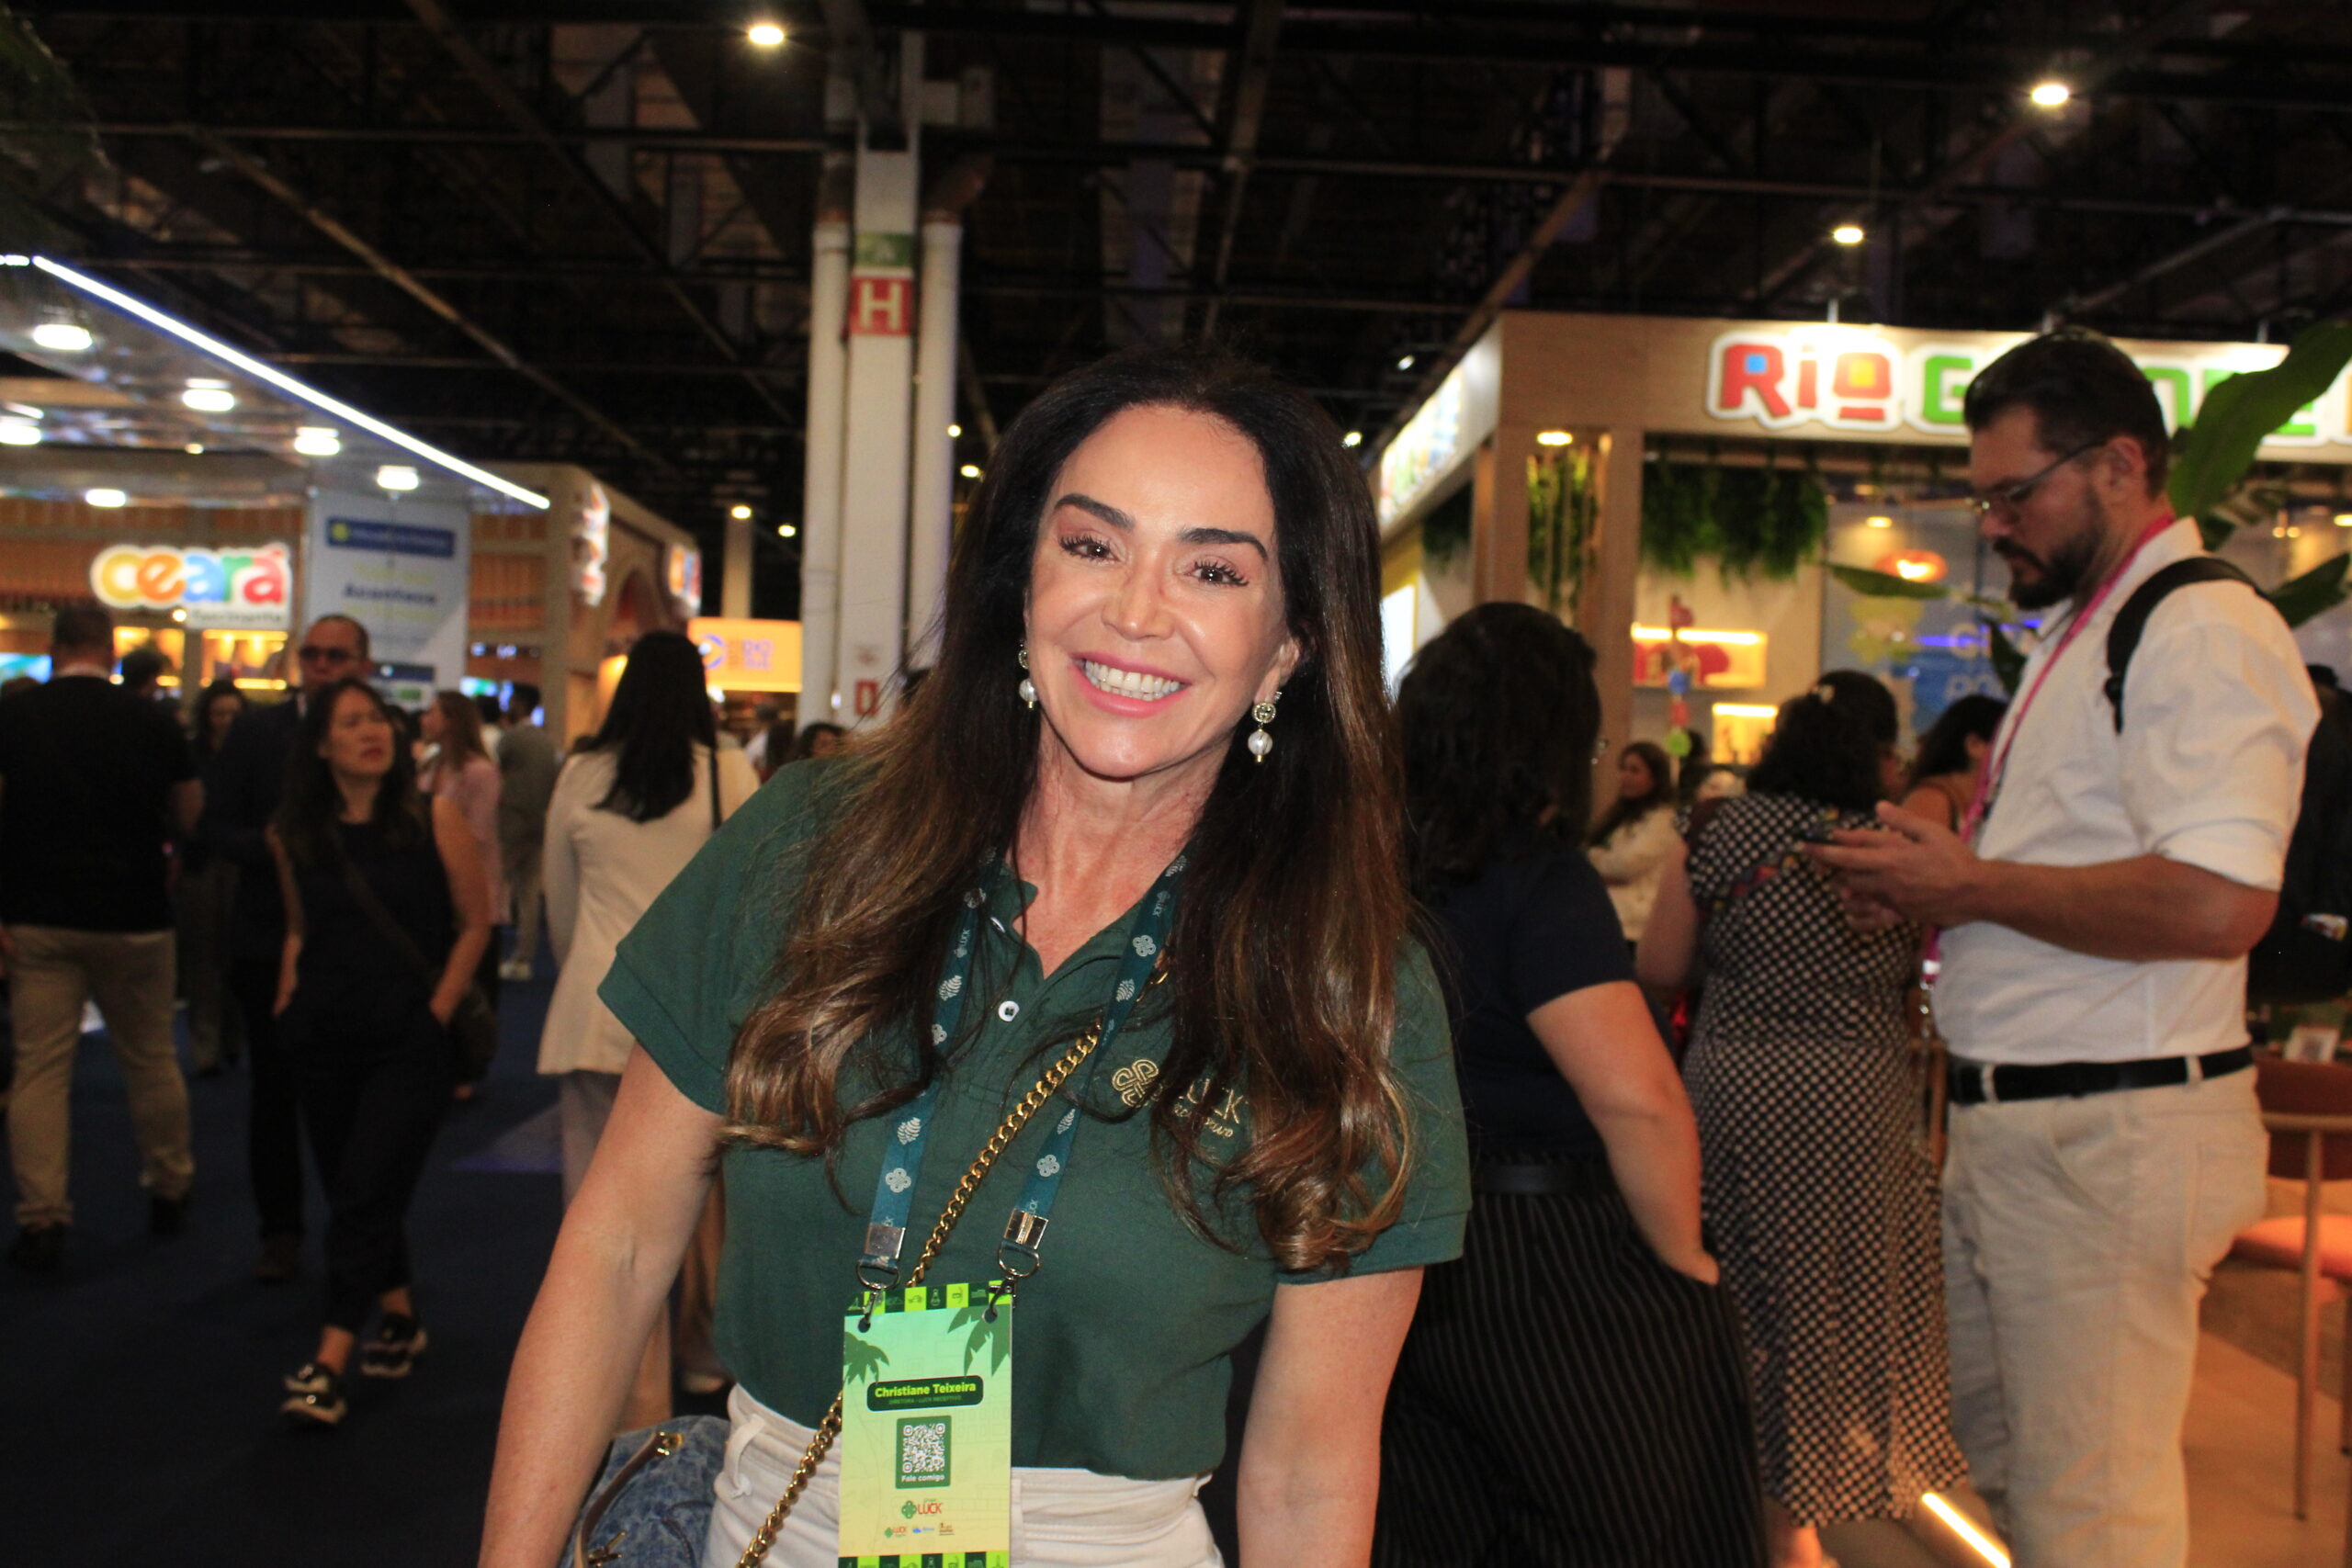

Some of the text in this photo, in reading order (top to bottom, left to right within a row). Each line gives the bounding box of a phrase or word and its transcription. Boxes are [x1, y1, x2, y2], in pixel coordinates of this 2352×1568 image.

[861, 281, 902, 329] H
[100, 548, 285, 604] ceará
[875, 1382, 977, 1398] Christiane Teixeira
[917, 1503, 943, 1515] LUCK
